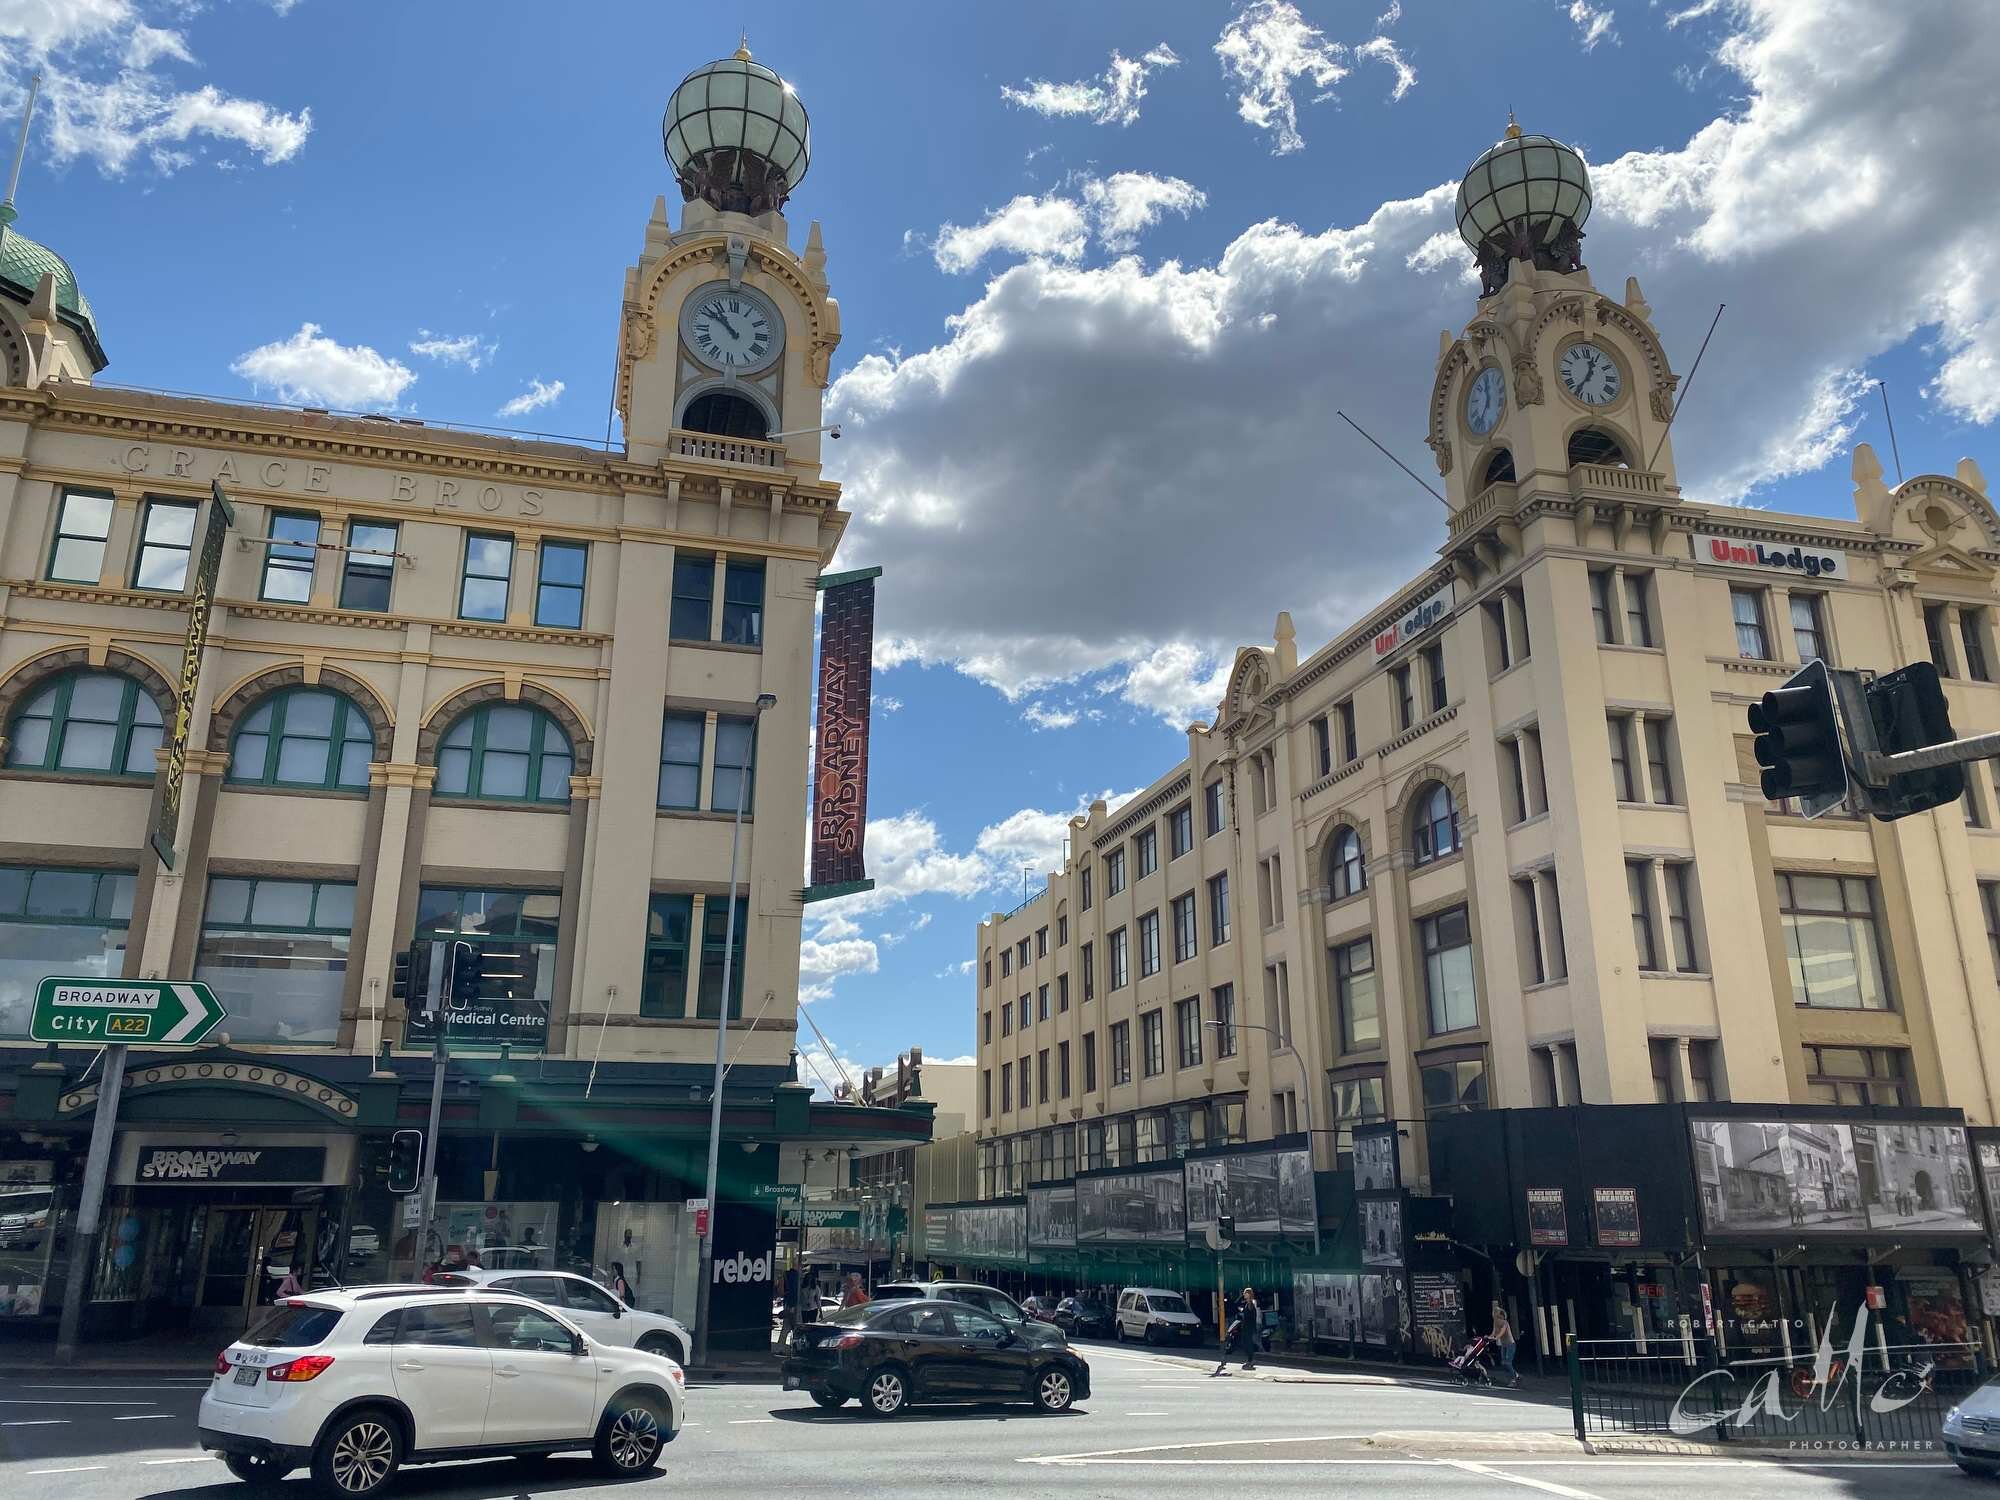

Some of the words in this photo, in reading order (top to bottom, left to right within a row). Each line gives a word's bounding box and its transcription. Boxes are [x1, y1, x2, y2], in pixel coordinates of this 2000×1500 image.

[121, 446, 330, 493] GRACE
[392, 475, 546, 517] BROS
[1711, 539, 1836, 576] UniLodge
[819, 658, 847, 842] BROADWAY
[838, 720, 863, 851] SYDNEY
[58, 991, 154, 1004] BROADWAY
[51, 1015, 99, 1034] City
[111, 1018, 145, 1032] A22
[443, 1012, 496, 1025] Medical
[500, 1013, 546, 1026] Centre
[152, 1151, 262, 1165] BROADWAY
[142, 1163, 224, 1178] SYDNEY
[764, 1185, 798, 1194] Broadway
[713, 1250, 772, 1284] rebel
